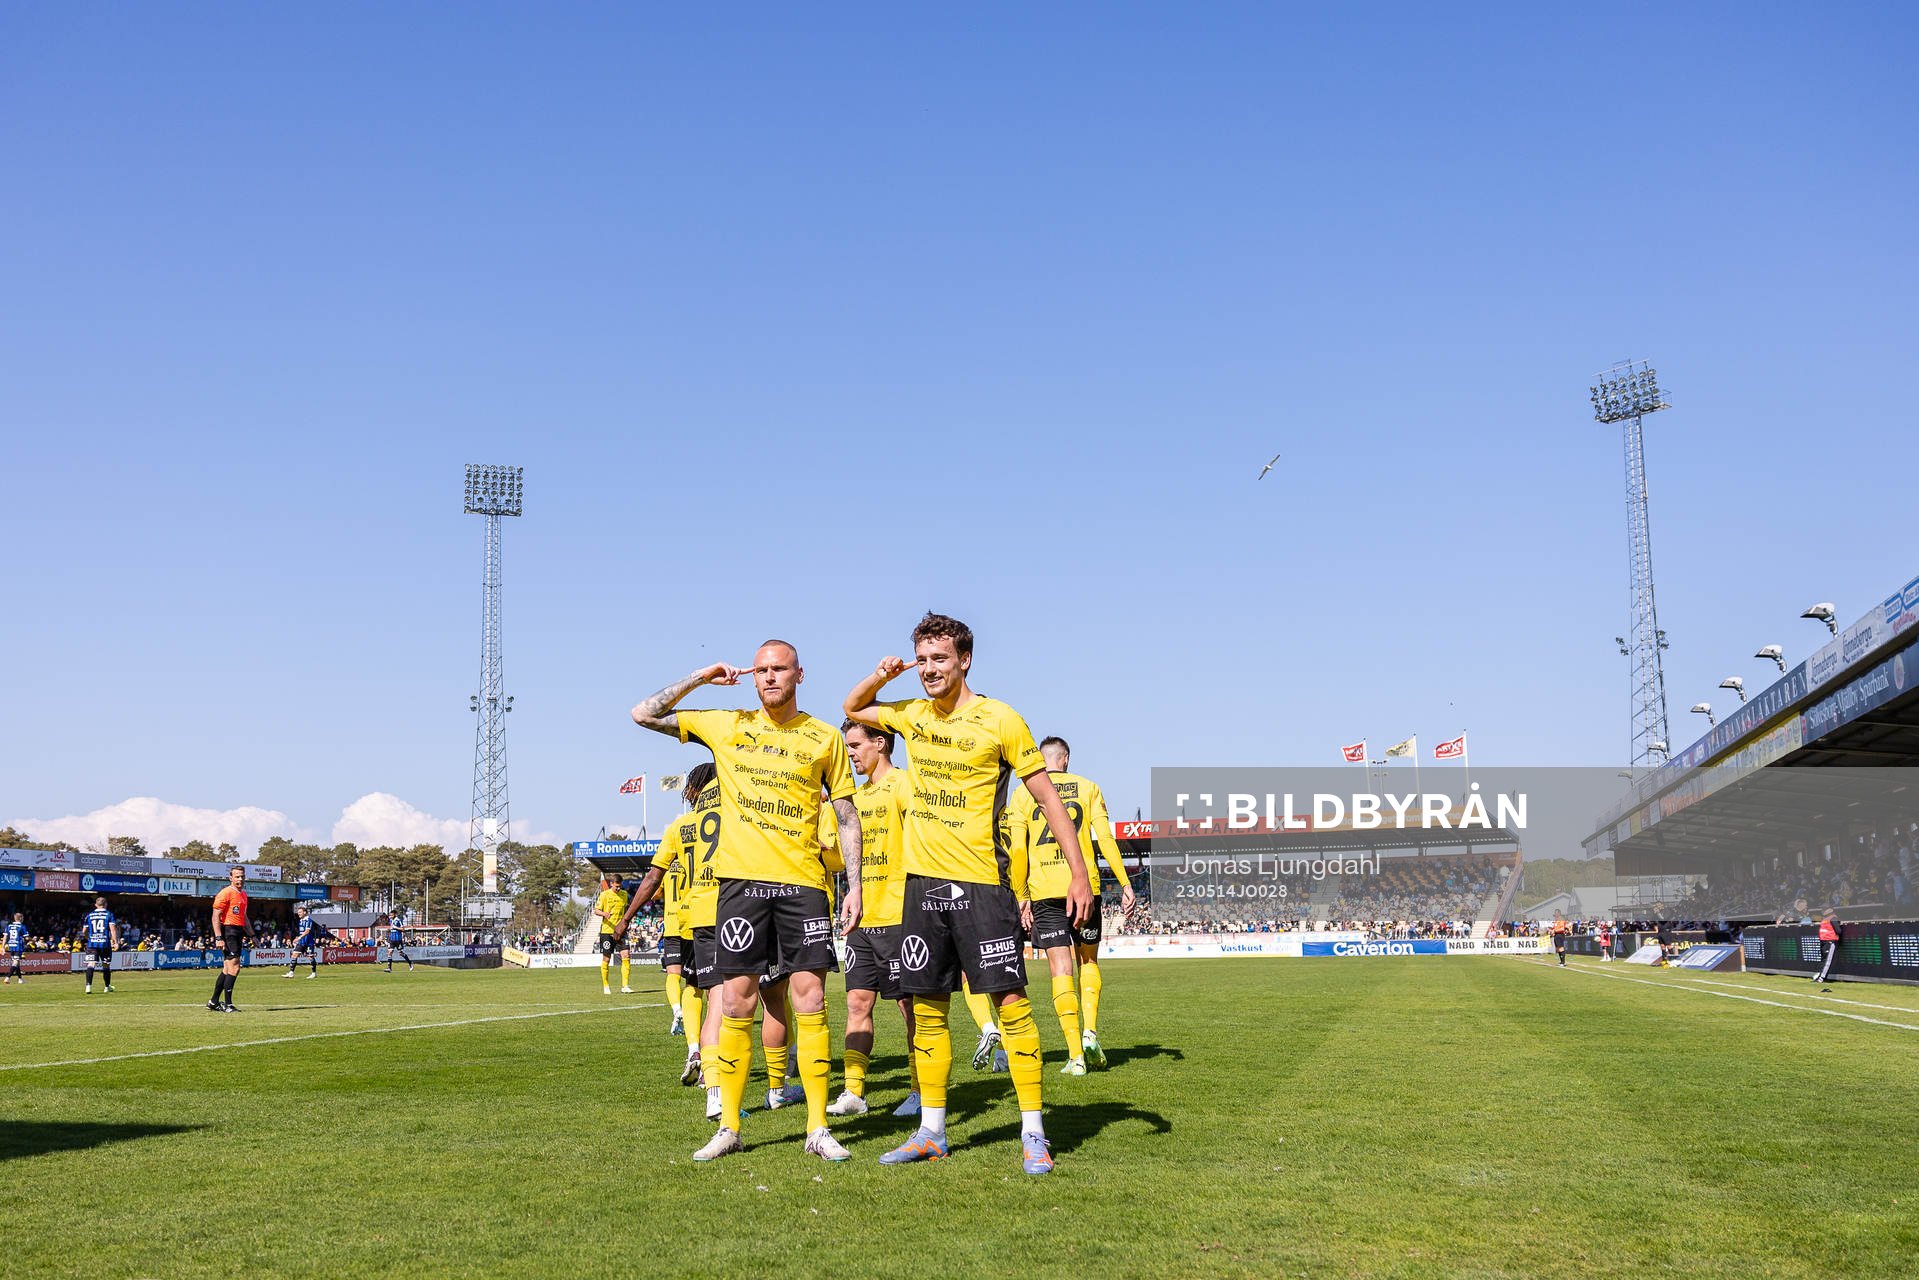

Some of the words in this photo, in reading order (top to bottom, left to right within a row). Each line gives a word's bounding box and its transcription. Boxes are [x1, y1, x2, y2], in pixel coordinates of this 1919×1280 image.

[750, 776, 789, 791] Sparbank
[737, 791, 775, 815] Sweden
[776, 799, 804, 820] Rock
[940, 789, 966, 808] Rock
[1123, 822, 1160, 838] EXTRA
[172, 881, 192, 890] KLF
[744, 886, 801, 899] SÄLJFAST
[921, 900, 970, 912] SÄLJFAST
[91, 919, 105, 933] 14
[979, 939, 1016, 955] LB-HUS
[1333, 941, 1415, 957] Caverion
[1449, 942, 1475, 950] NABO
[1483, 941, 1510, 949] NABO
[1518, 940, 1539, 949] NAB
[41, 958, 69, 967] kommun
